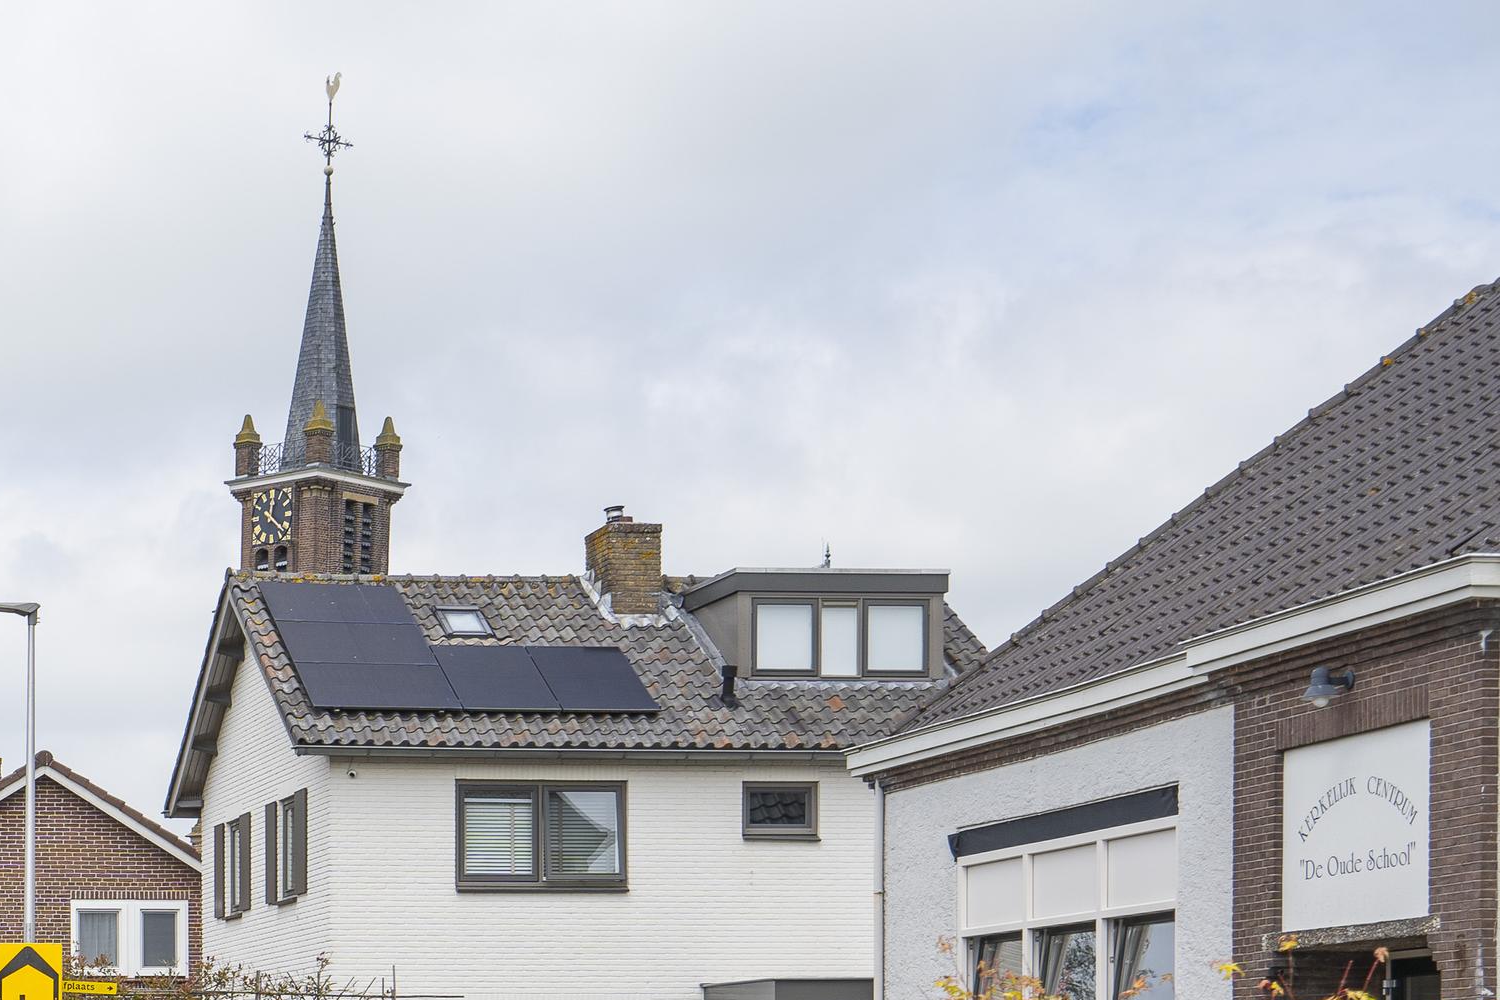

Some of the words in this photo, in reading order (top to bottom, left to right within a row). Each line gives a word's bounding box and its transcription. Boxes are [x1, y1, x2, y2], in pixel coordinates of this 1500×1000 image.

[1298, 776, 1357, 843] KERKELIJK
[1367, 775, 1418, 825] CENTRUM
[1300, 858, 1323, 881] "De
[1327, 852, 1363, 877] Oude
[1366, 841, 1416, 872] School"
[63, 981, 95, 991] fplaats
